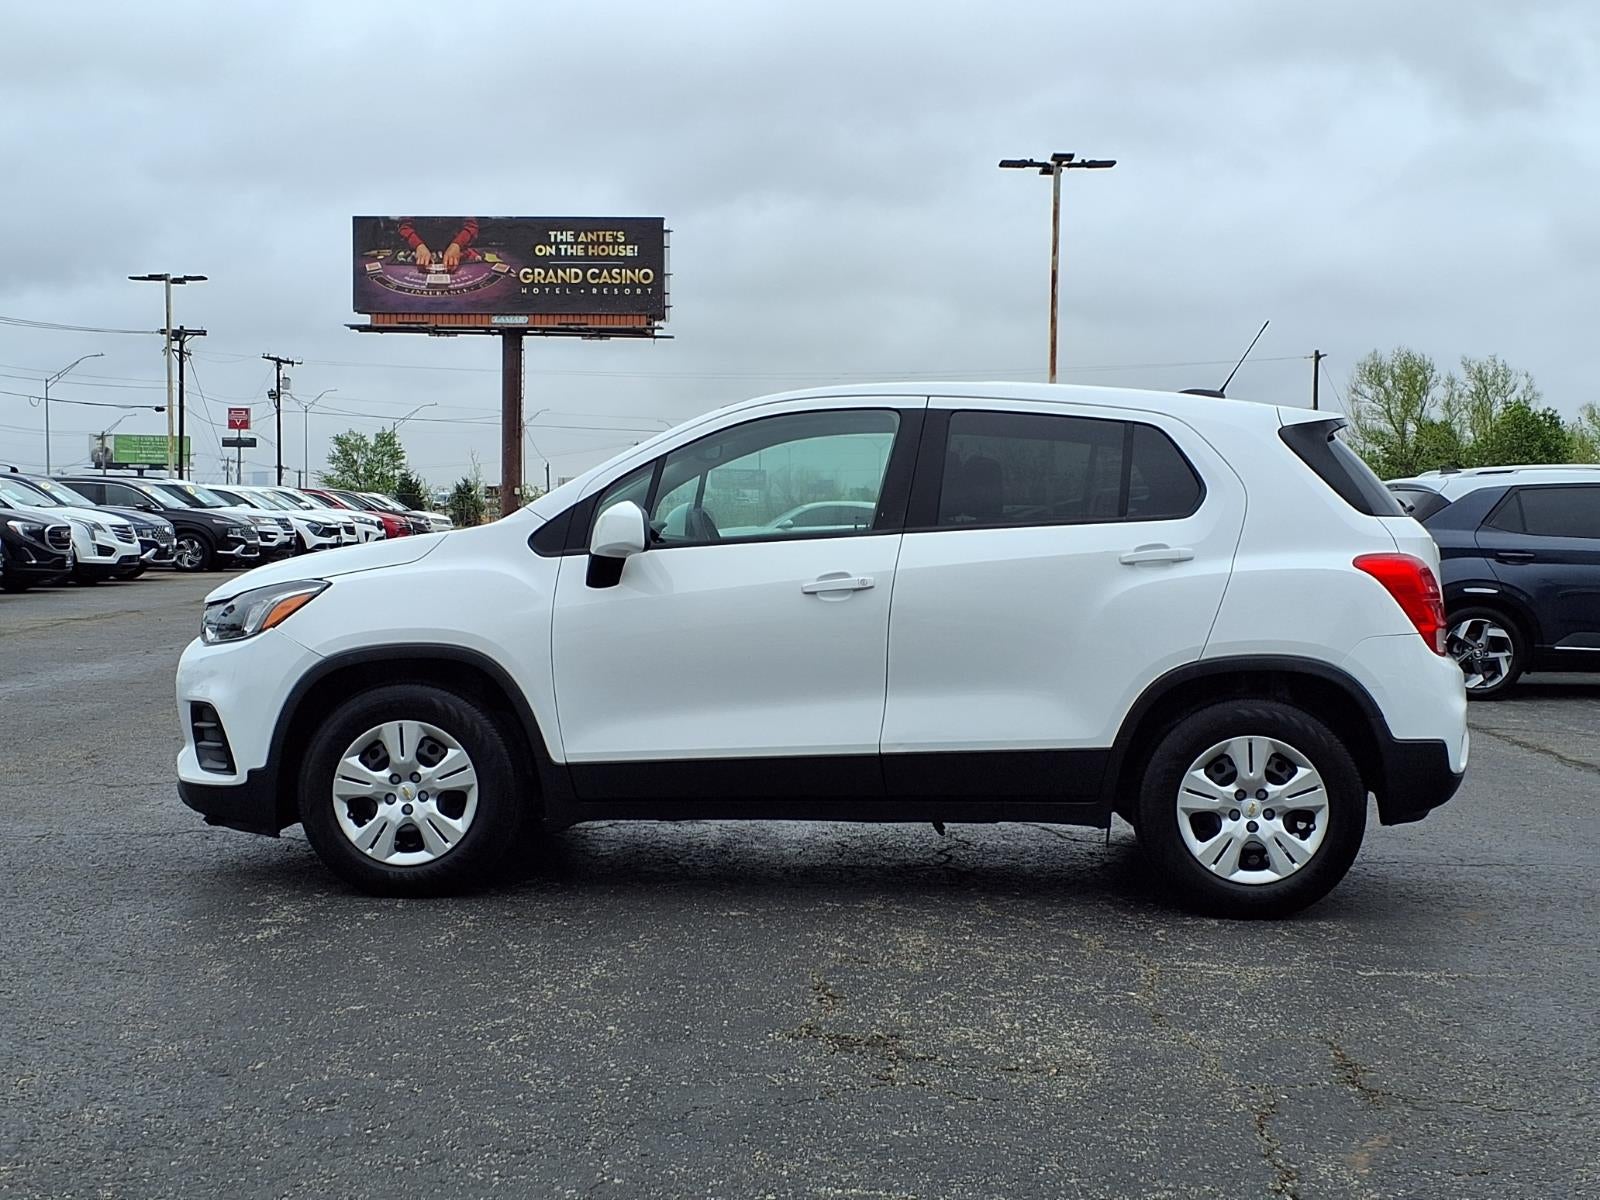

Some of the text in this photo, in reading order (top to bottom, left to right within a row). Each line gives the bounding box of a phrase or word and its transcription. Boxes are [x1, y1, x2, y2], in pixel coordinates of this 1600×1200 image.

[549, 231, 625, 242] THE ANTE'S
[534, 245, 638, 256] ON THE HOUSE!
[519, 268, 654, 284] GRAND CASINO
[521, 287, 653, 295] HOTEL RESORT
